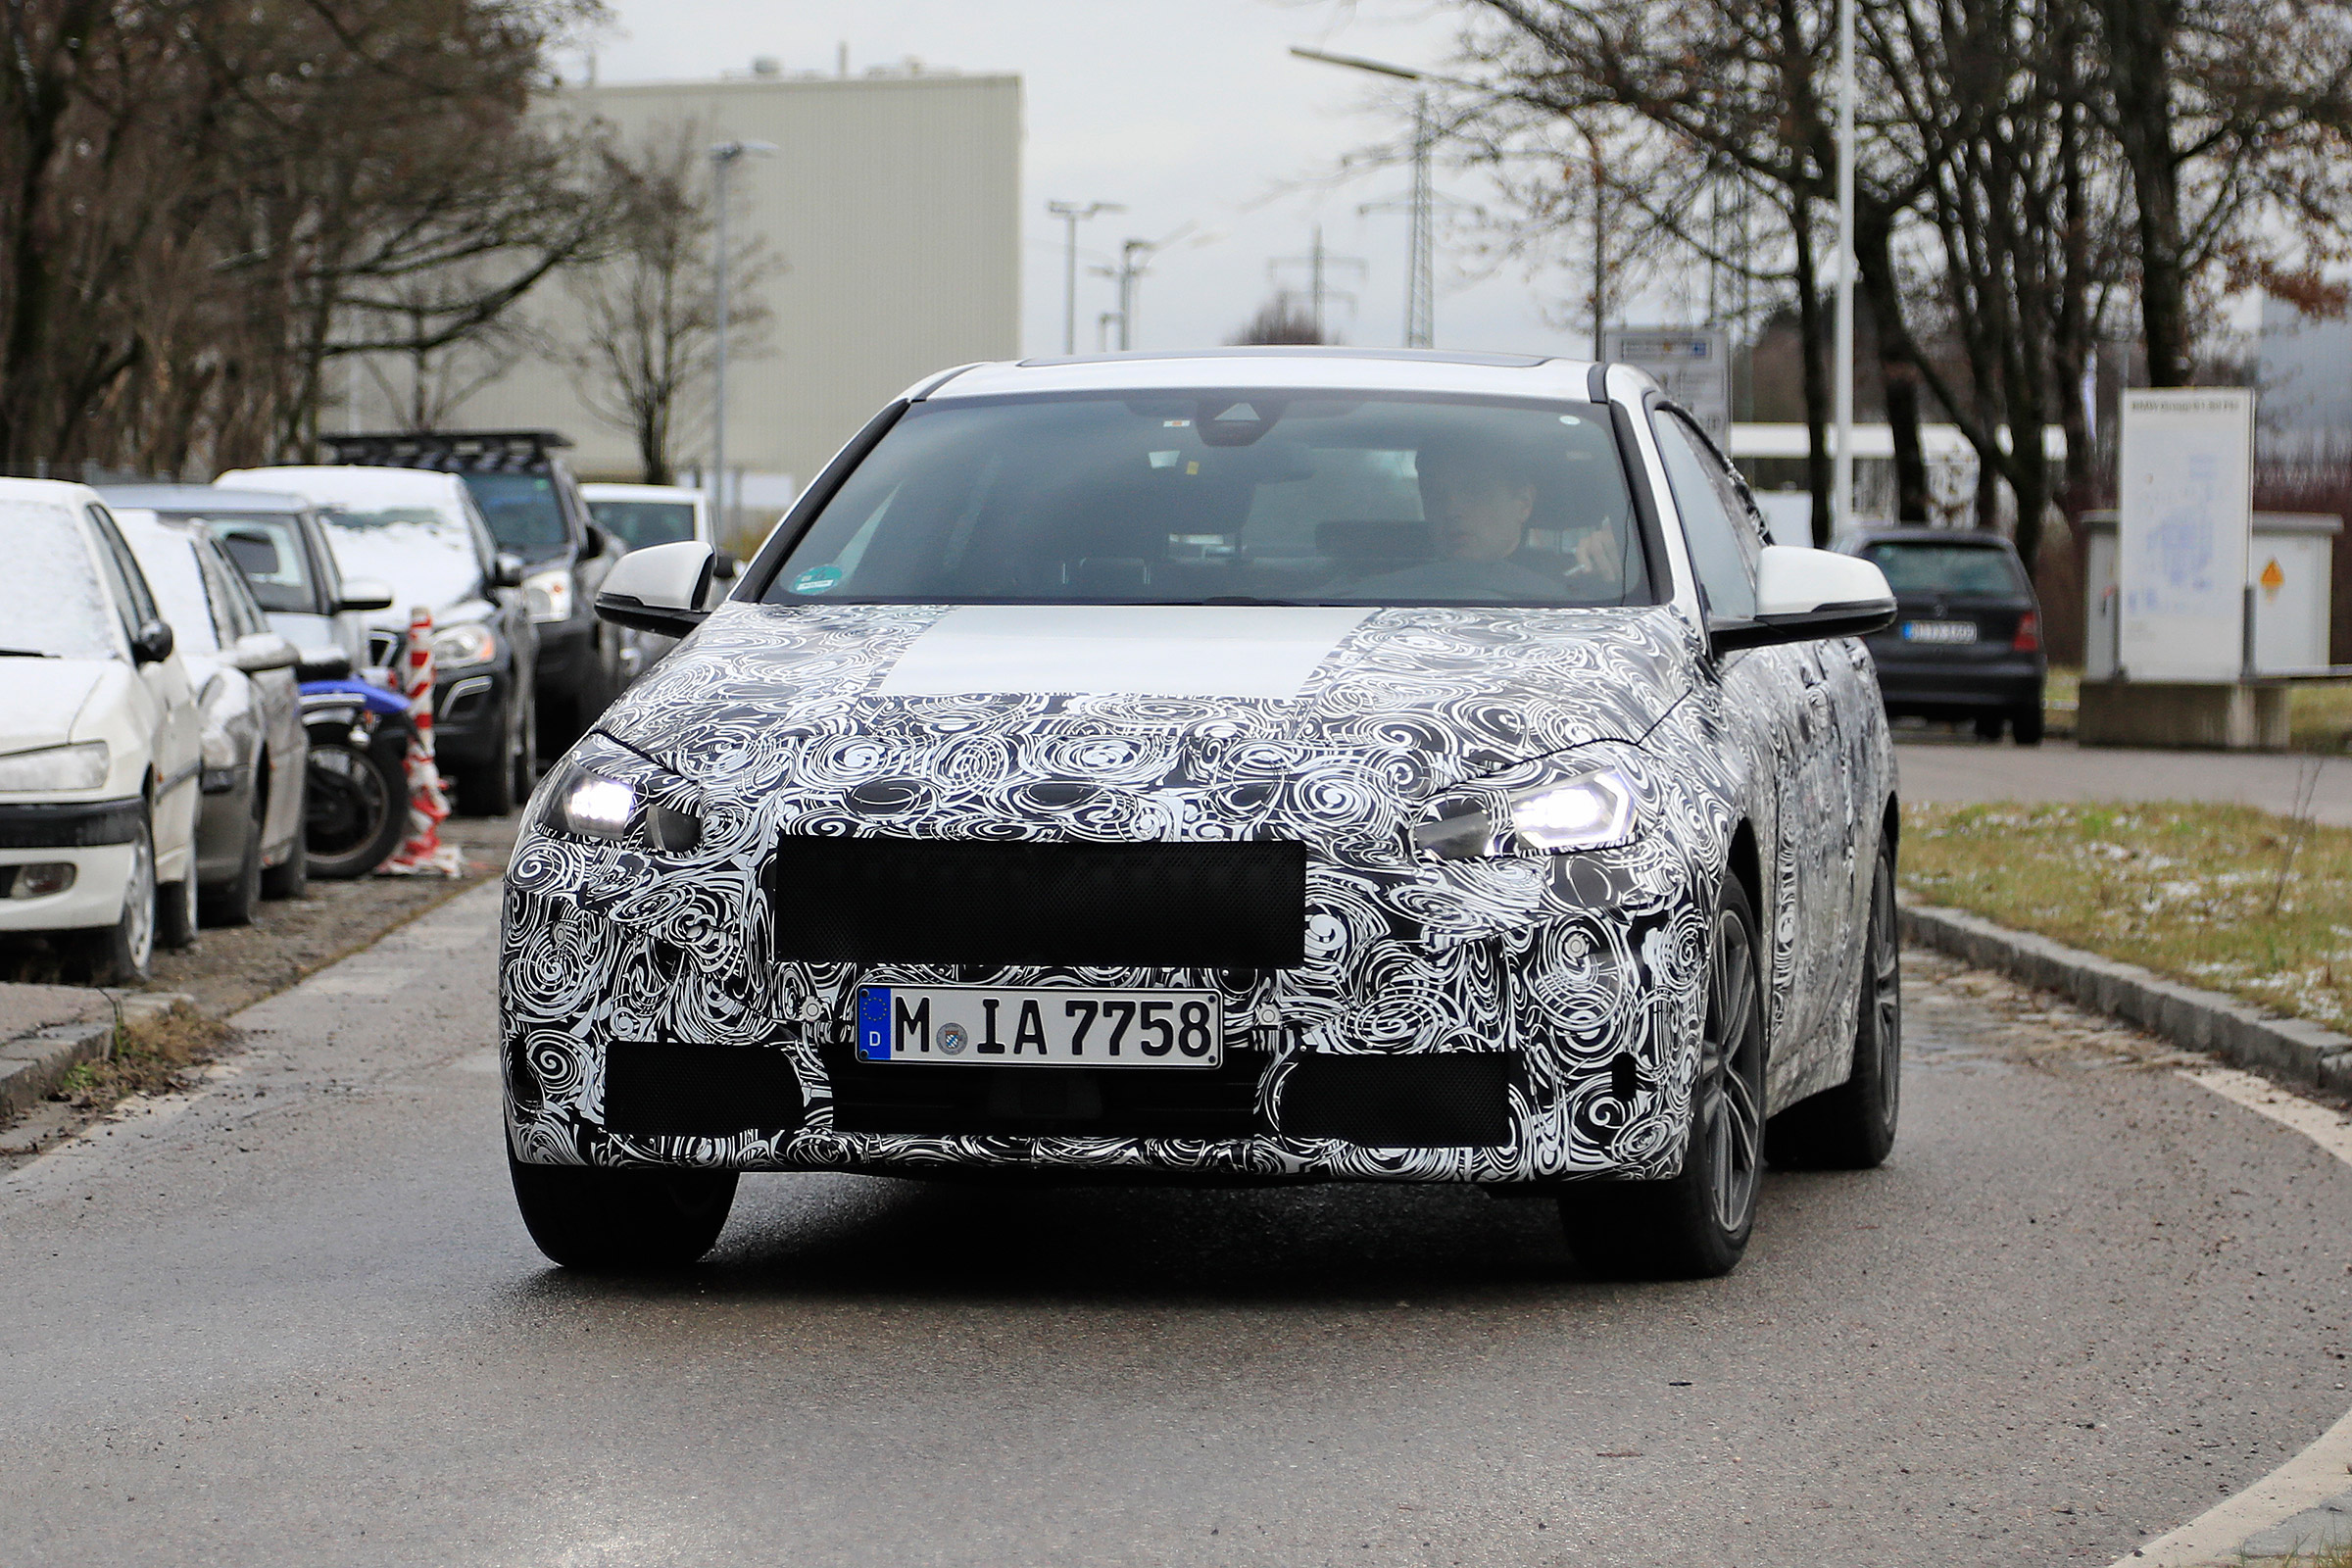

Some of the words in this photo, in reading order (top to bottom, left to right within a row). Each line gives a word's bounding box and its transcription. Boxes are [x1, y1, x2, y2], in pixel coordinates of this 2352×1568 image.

[869, 1031, 881, 1047] D
[895, 996, 930, 1053] M
[977, 998, 1048, 1055] IA
[1065, 1000, 1212, 1057] 7758
